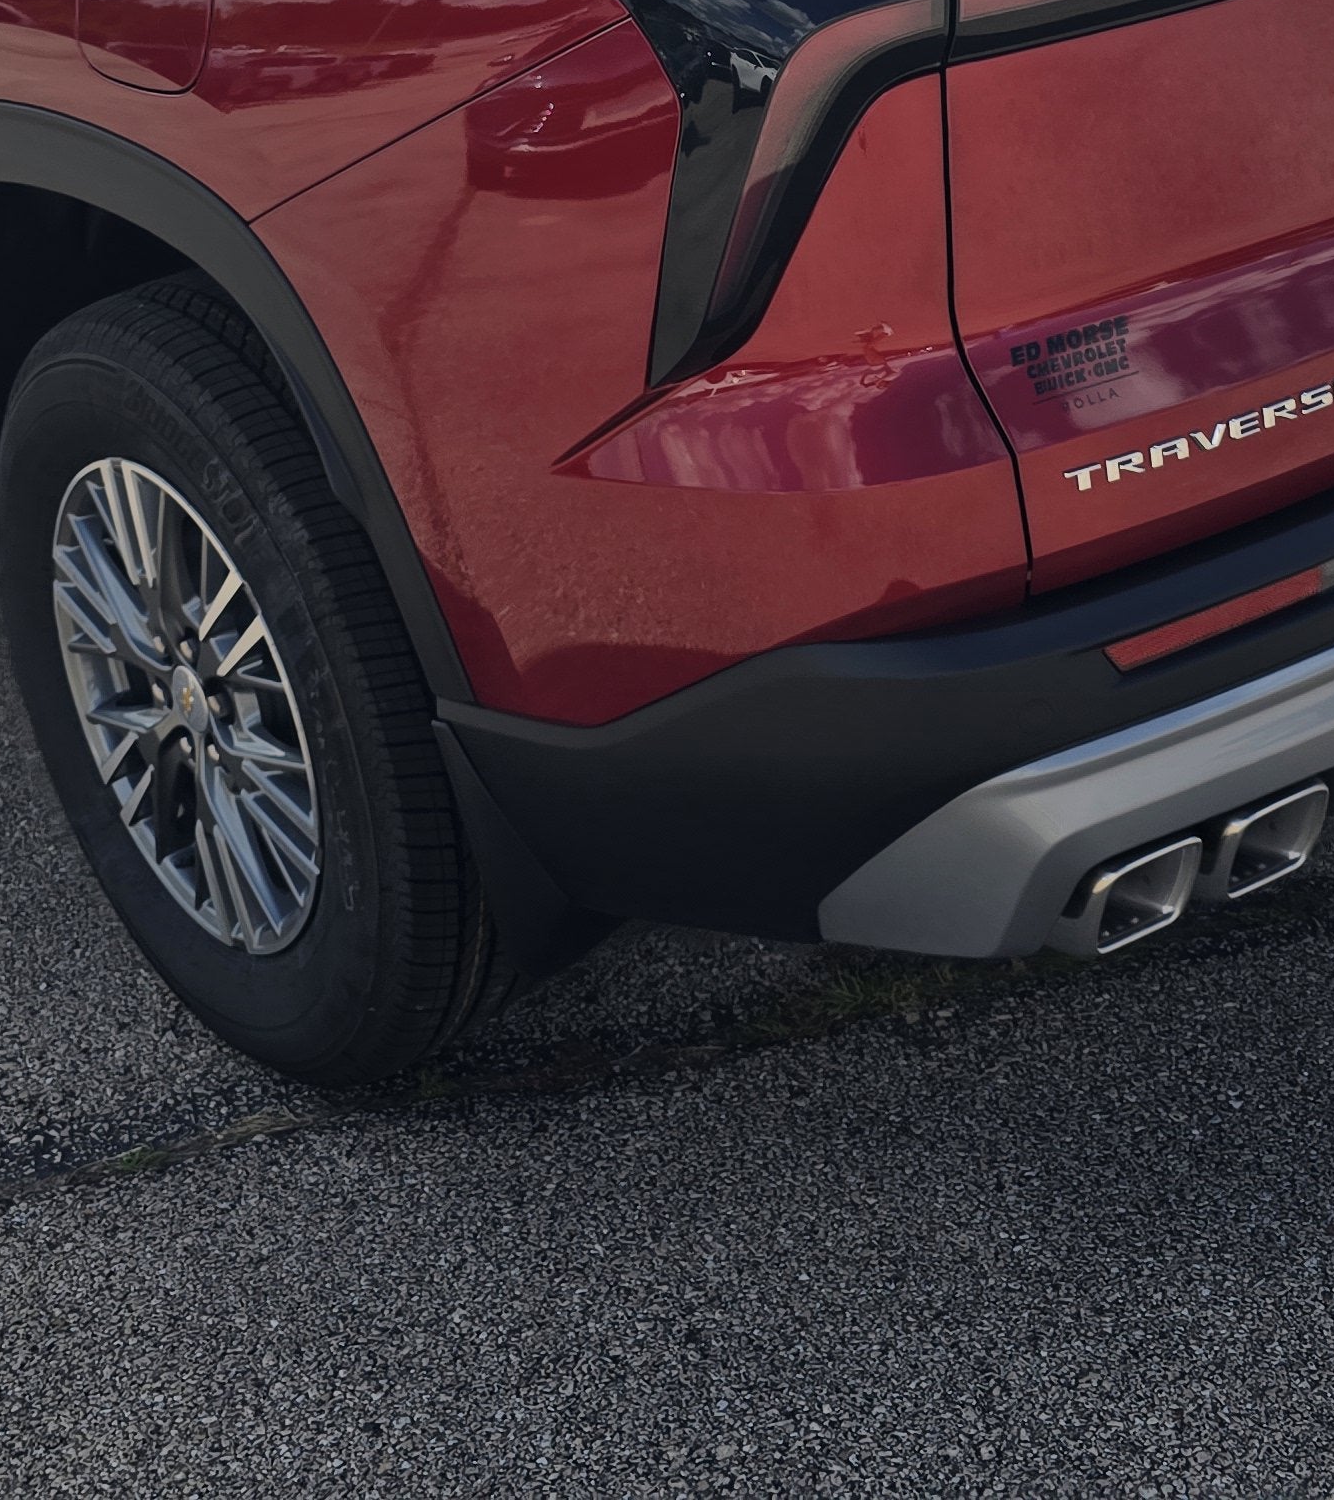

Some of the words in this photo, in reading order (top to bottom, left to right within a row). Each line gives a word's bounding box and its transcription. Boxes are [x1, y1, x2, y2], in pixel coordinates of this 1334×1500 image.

[1010, 341, 1041, 367] ED
[1046, 315, 1129, 355] MORSE
[1027, 338, 1127, 378] CHEVROLET
